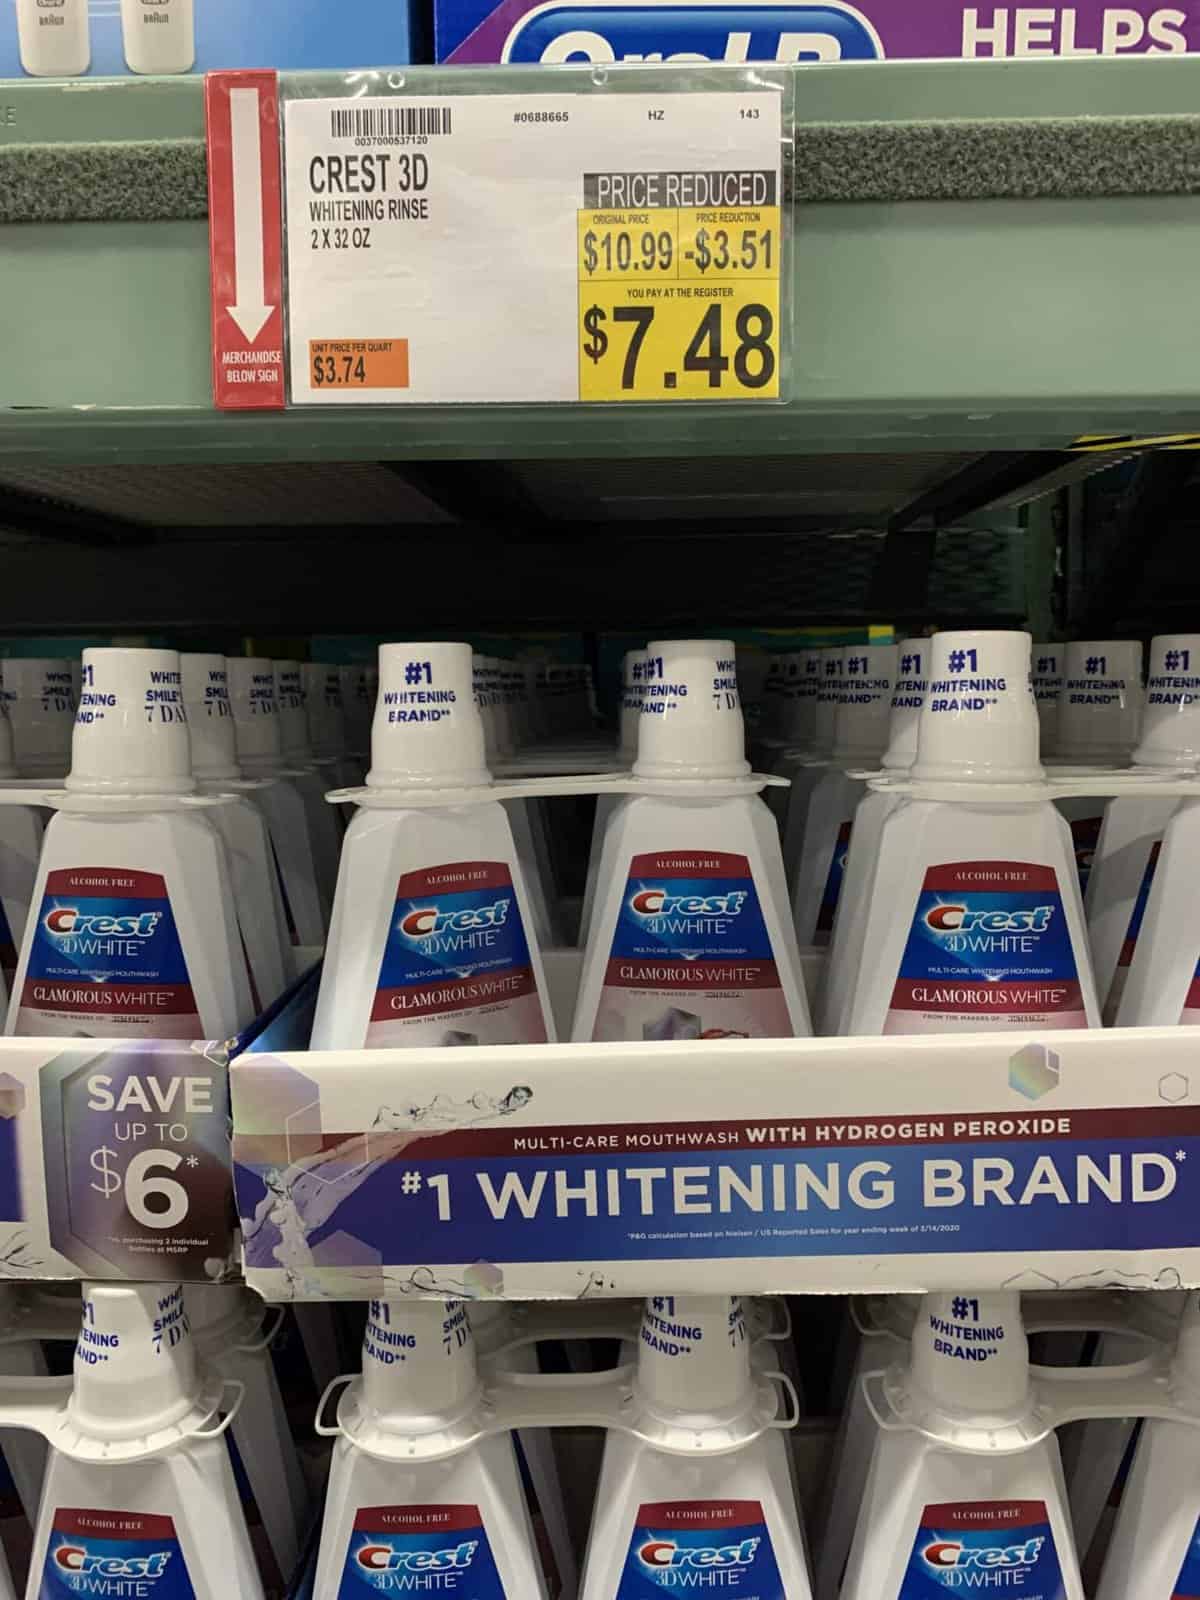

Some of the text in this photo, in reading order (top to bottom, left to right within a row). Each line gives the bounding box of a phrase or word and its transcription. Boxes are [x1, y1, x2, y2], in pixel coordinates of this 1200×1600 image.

[961, 7, 1187, 58] HELPS
[513, 111, 569, 123] #0688665
[648, 110, 665, 121] HZ
[739, 109, 760, 119] 143
[355, 136, 428, 147] 0037000537120
[309, 153, 429, 193] CREST 3D
[597, 172, 768, 208] PRICE REDUCED
[309, 198, 429, 221] WHITENING RINSE
[592, 214, 649, 225] ORIGINAL PRICE
[696, 212, 761, 223] PRICE REDUCTION
[311, 227, 371, 249] 2 X 32 OZ
[583, 229, 673, 276] $10.99
[684, 227, 772, 275] -$3.51
[627, 287, 733, 298] YOU PAY AT THE REGISTER
[312, 342, 392, 353] UNIT PRICE PER QUART
[583, 303, 775, 390] $7.48
[222, 350, 281, 364] MERCHANDISE
[226, 369, 278, 383] BELOW SIGN
[313, 355, 366, 386] $3.74
[848, 656, 869, 675] #1
[901, 654, 921, 674] #1
[948, 648, 978, 673] #1
[1085, 656, 1106, 675] #1
[1165, 650, 1189, 671] #1
[404, 660, 433, 685] #1
[931, 678, 1006, 693] WHITENING
[384, 690, 457, 705] WHITENING
[144, 705, 154, 722] 7
[620, 965, 703, 981] GLAMOROUS
[33, 986, 112, 1004] GLAMOROUS
[390, 986, 478, 1010] GLAMOROUS
[911, 987, 1007, 1004] GLAMOROUS
[87, 1074, 213, 1113] SAVE
[115, 1122, 188, 1142] UP TO
[513, 1118, 1071, 1150] MULTI-CARE MOUTHWASH WITH HYDROGEN PEROXIDE
[401, 1171, 451, 1221] #1
[475, 1161, 895, 1220] WHITENING
[951, 1296, 979, 1321] #1
[929, 1315, 1004, 1341] WHITENING
